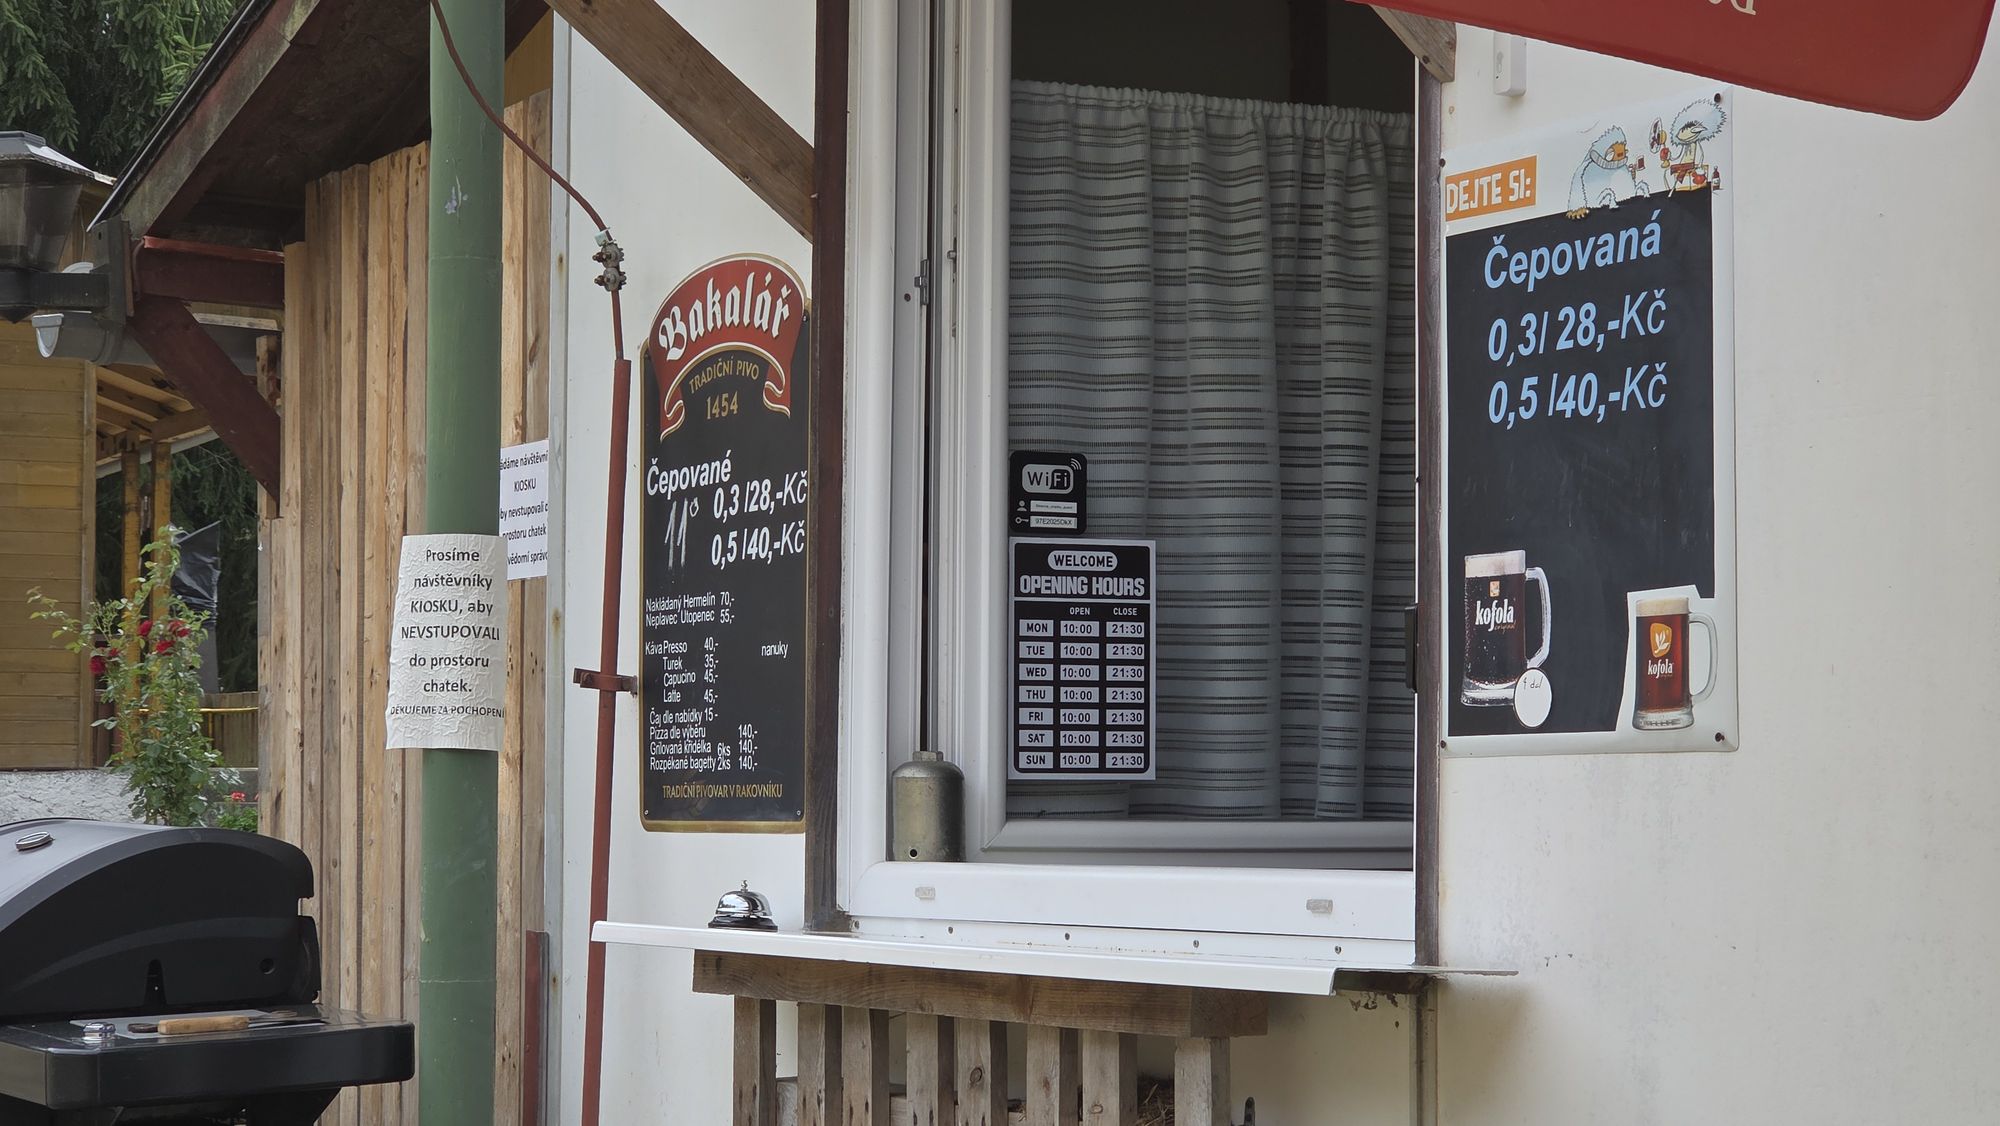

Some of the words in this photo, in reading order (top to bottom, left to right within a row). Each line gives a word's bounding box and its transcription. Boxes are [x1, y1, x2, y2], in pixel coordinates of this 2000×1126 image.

[1446, 173, 1502, 214] DEJTE
[1508, 168, 1531, 199] SI:
[1484, 209, 1662, 293] Čepovaná
[658, 272, 792, 361] Bakalář
[689, 356, 734, 394] TRADIČNÍ
[736, 360, 760, 380] PIVO
[706, 391, 739, 419] 1454
[520, 450, 548, 466] návštěvní
[646, 450, 732, 500] Čepované
[514, 478, 536, 492] KIOSKU
[508, 501, 545, 517] nevstupovali
[528, 523, 547, 538] chatek
[426, 548, 480, 562] Prosíme
[1054, 554, 1113, 568] WELCOME
[414, 574, 492, 591] návštěvníky
[1020, 575, 1088, 594] OPENING
[1092, 577, 1144, 596] HOURS
[410, 600, 463, 615] KIOSKU,
[468, 600, 493, 616] aby
[645, 594, 682, 613] Nakládaný
[683, 592, 716, 609] Hermelín
[720, 591, 735, 607] 70,-
[645, 612, 678, 629] Neplavec
[680, 609, 715, 626] Utopenec
[720, 608, 735, 624] 55,-
[1070, 607, 1090, 615] OPEN
[1475, 599, 1514, 632] kofola
[401, 625, 500, 640] NEVSTUPOVALI
[1027, 623, 1047, 632] MON
[1064, 624, 1092, 634] 10:00
[1112, 624, 1142, 634] 21:30
[645, 641, 663, 655] Káva
[663, 640, 688, 654] Presso
[704, 636, 719, 652] 40,-
[761, 641, 788, 659] nanuky
[1026, 646, 1044, 655] TUE
[1064, 646, 1092, 656] 10:00
[1113, 646, 1142, 655] 21:30
[409, 654, 426, 667] do
[431, 655, 489, 670] prostoru
[663, 656, 683, 670] Turek
[704, 654, 719, 669] 35,-
[1647, 659, 1673, 679] kofola
[663, 669, 696, 688] Capucino
[704, 669, 719, 684] 45,-
[1026, 668, 1046, 676] WED
[1063, 668, 1090, 677] 10:00
[1113, 668, 1142, 678] 21:30
[423, 679, 472, 692] chatek.
[704, 689, 719, 704] 45,-
[1026, 690, 1045, 699] THU
[1064, 690, 1092, 700] 10:00
[1112, 691, 1142, 700] 21:30
[437, 705, 448, 715] ZA
[649, 707, 661, 727] Čaj
[663, 710, 674, 724] dle
[675, 708, 702, 726] nabídky
[1029, 712, 1043, 721] FRI
[1063, 713, 1090, 722] 10:00
[1112, 712, 1142, 722] 21:30
[649, 726, 668, 740] Pizza
[670, 725, 681, 739] dle
[738, 724, 758, 739] 140,-
[1028, 734, 1045, 743] SAT
[1062, 733, 1091, 744] 10:00
[1112, 733, 1143, 744] 21:30
[717, 743, 731, 757] 6ks
[738, 739, 758, 755] 140,-
[689, 756, 716, 772] bagetty
[717, 756, 731, 770] 2ks
[738, 755, 758, 771] 140,-
[1026, 755, 1045, 764] SUN
[1062, 755, 1091, 765] 10:00
[1112, 755, 1143, 766] 21:30
[662, 781, 696, 798] TRADIČNÍ
[696, 784, 728, 798] PIVOVAR
[729, 784, 735, 797] V
[736, 780, 783, 798] RAKOVNÍKU
